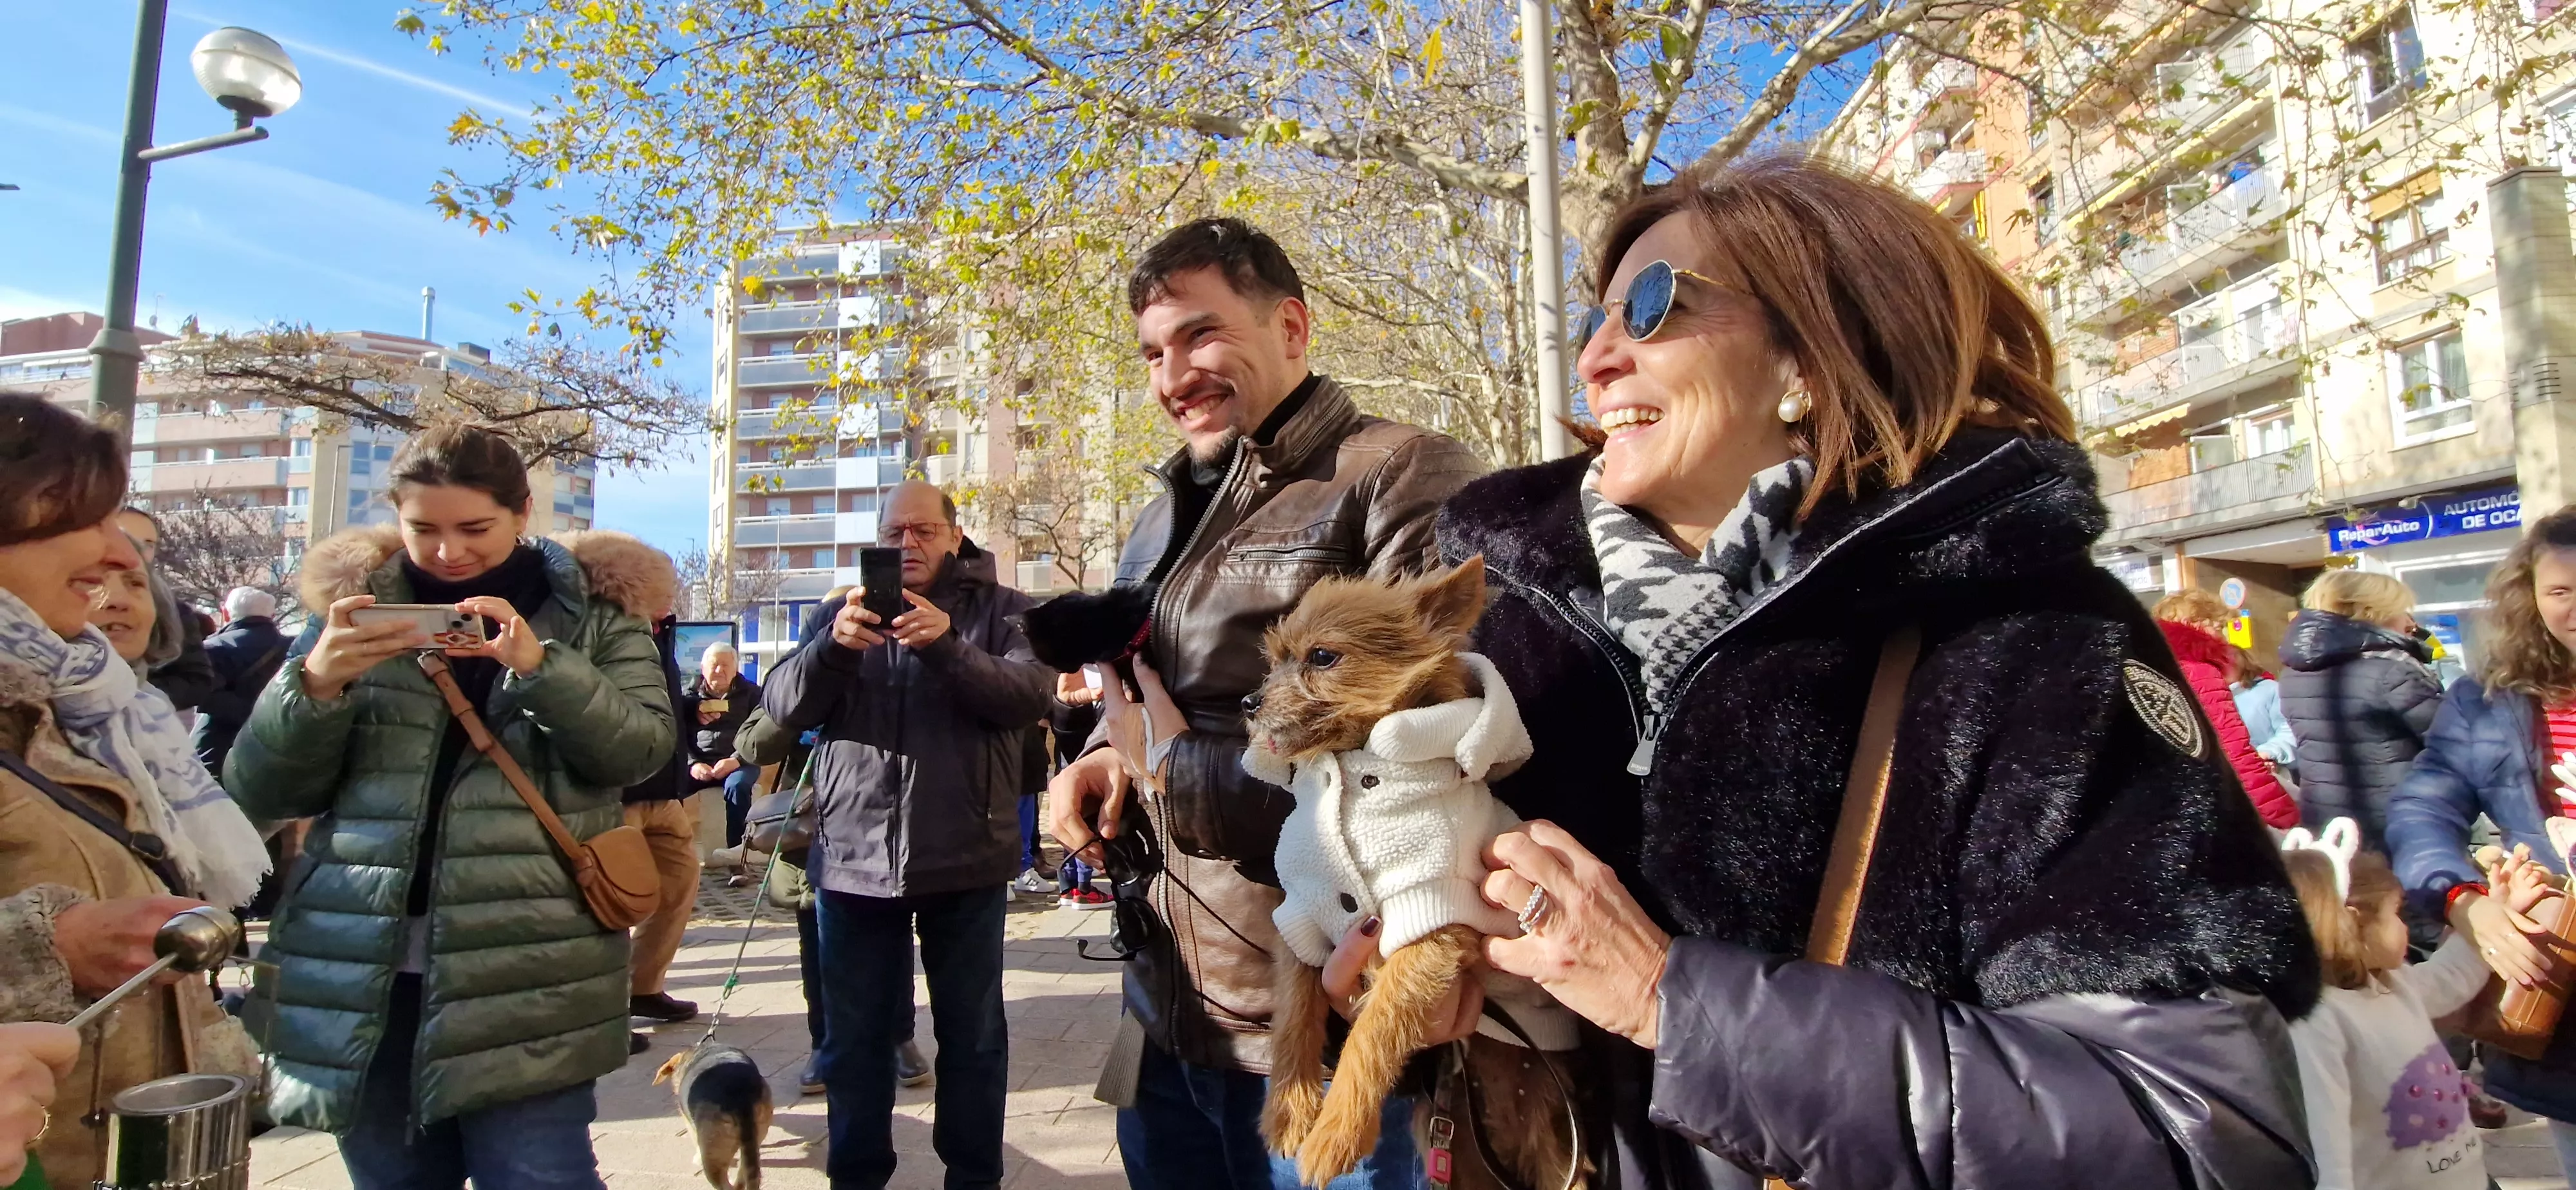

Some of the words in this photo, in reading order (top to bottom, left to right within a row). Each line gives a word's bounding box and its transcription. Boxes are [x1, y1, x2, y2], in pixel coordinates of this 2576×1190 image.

[2444, 490, 2520, 516] AUTOMÓ
[2462, 511, 2486, 529] DE
[2338, 521, 2420, 542] ReparAuto
[2426, 1150, 2461, 1173] LOVE
